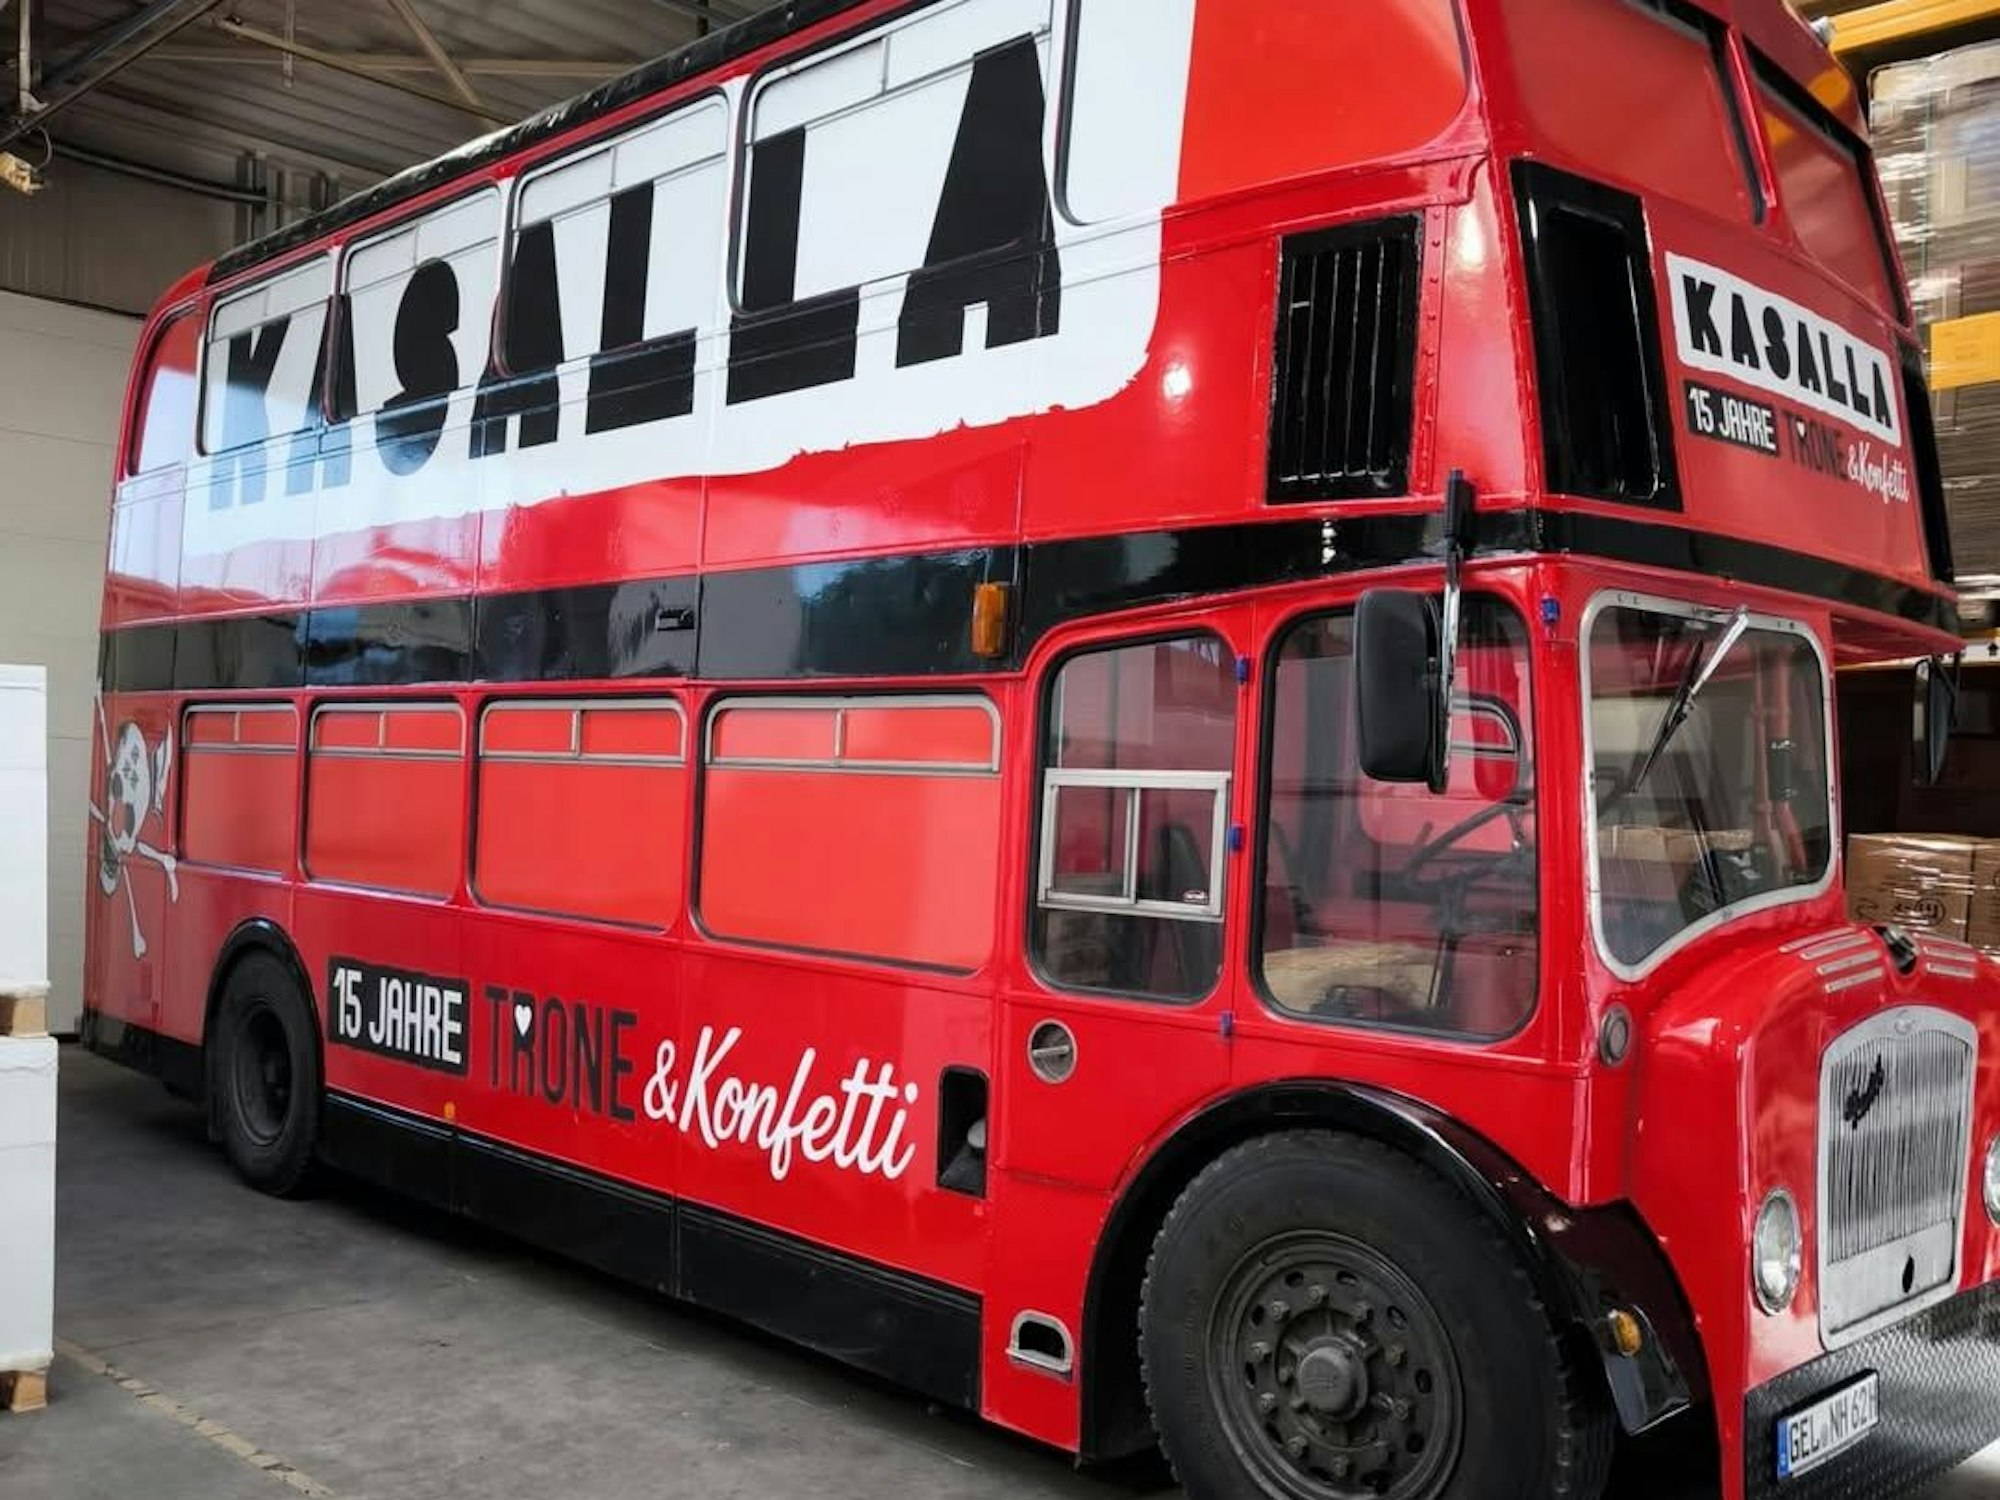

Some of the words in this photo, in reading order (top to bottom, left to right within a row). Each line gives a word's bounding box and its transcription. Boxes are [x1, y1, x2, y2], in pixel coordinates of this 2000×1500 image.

[207, 31, 1061, 511] KASALLA
[1682, 273, 1893, 429] KASALLA
[1689, 387, 1714, 433] 15
[1718, 395, 1777, 451] JAHRE
[1782, 409, 1848, 481] TRONE
[332, 967, 362, 1039] 15
[369, 976, 463, 1065] JAHRE
[484, 984, 638, 1124] TRONE
[1790, 1415, 1820, 1463] GEL
